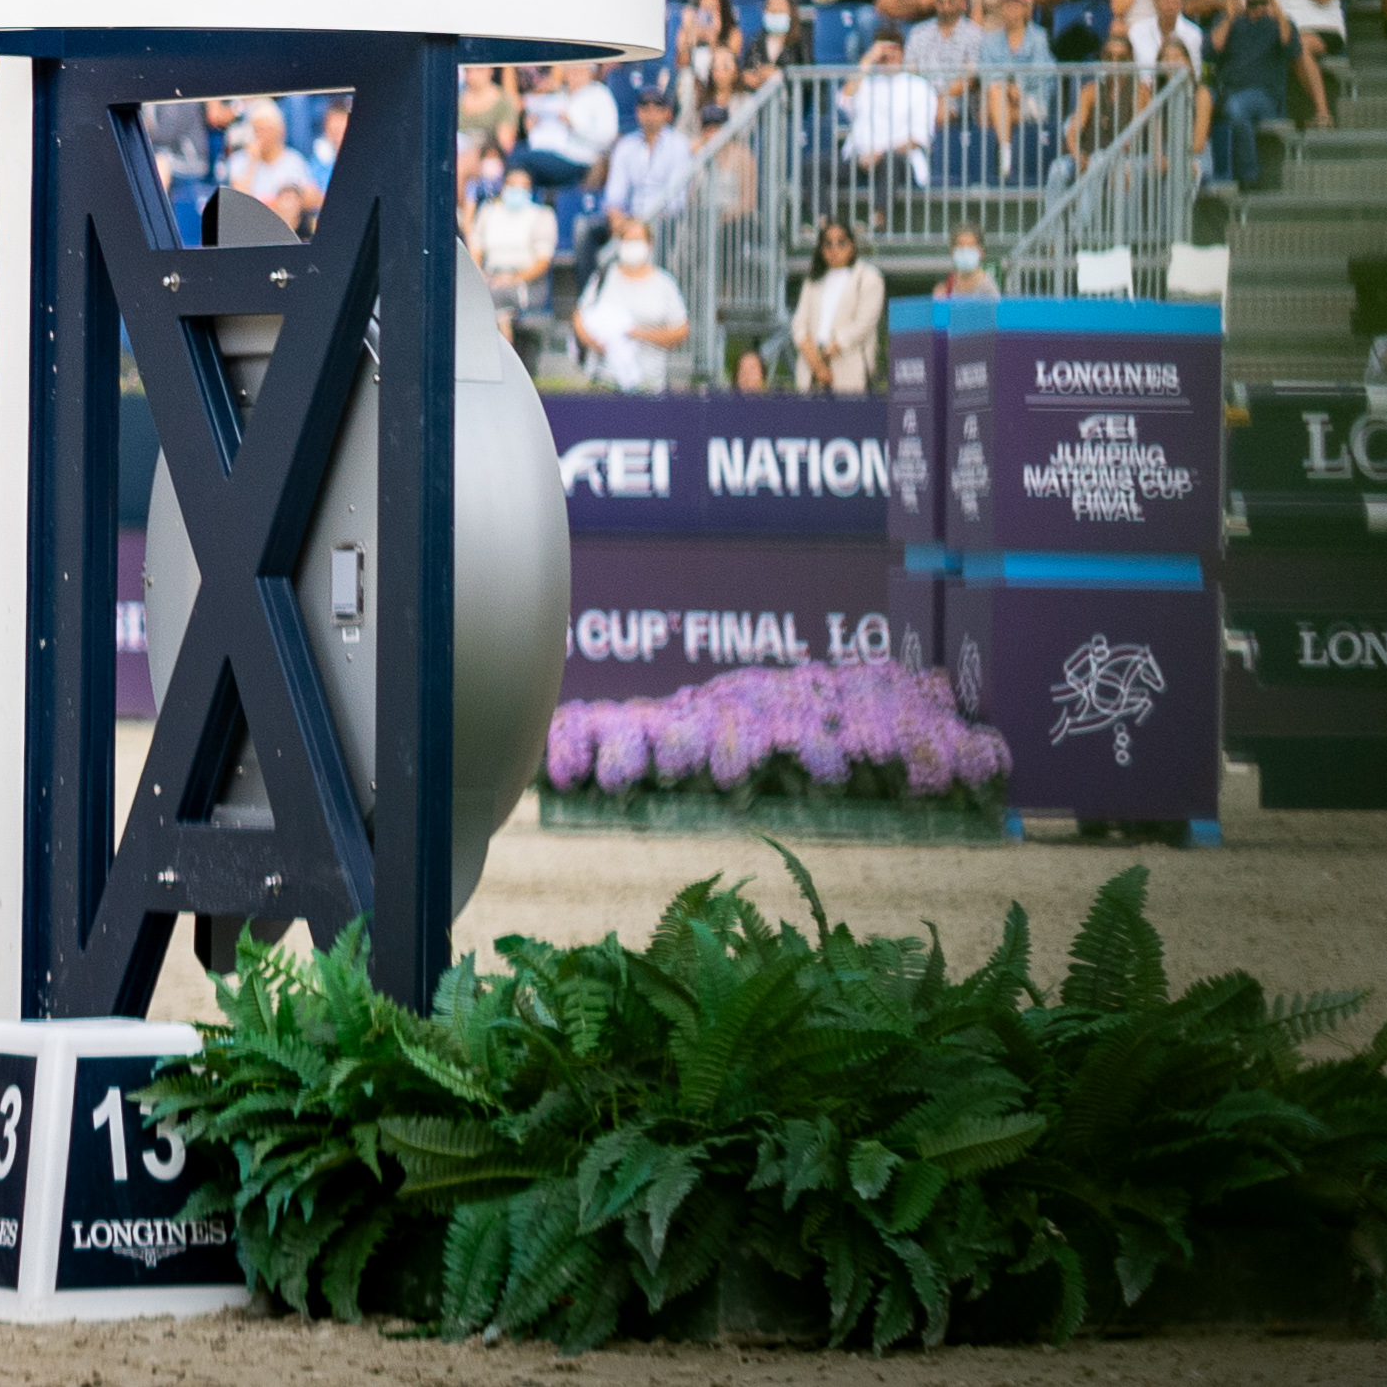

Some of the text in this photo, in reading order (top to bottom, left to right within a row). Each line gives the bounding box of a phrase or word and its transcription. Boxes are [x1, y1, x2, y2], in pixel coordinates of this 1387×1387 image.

[1035, 359, 1182, 397] LONGINES
[577, 610, 670, 662] CUP
[684, 611, 811, 663] FINAL
[71, 1218, 227, 1250] LONGINES
